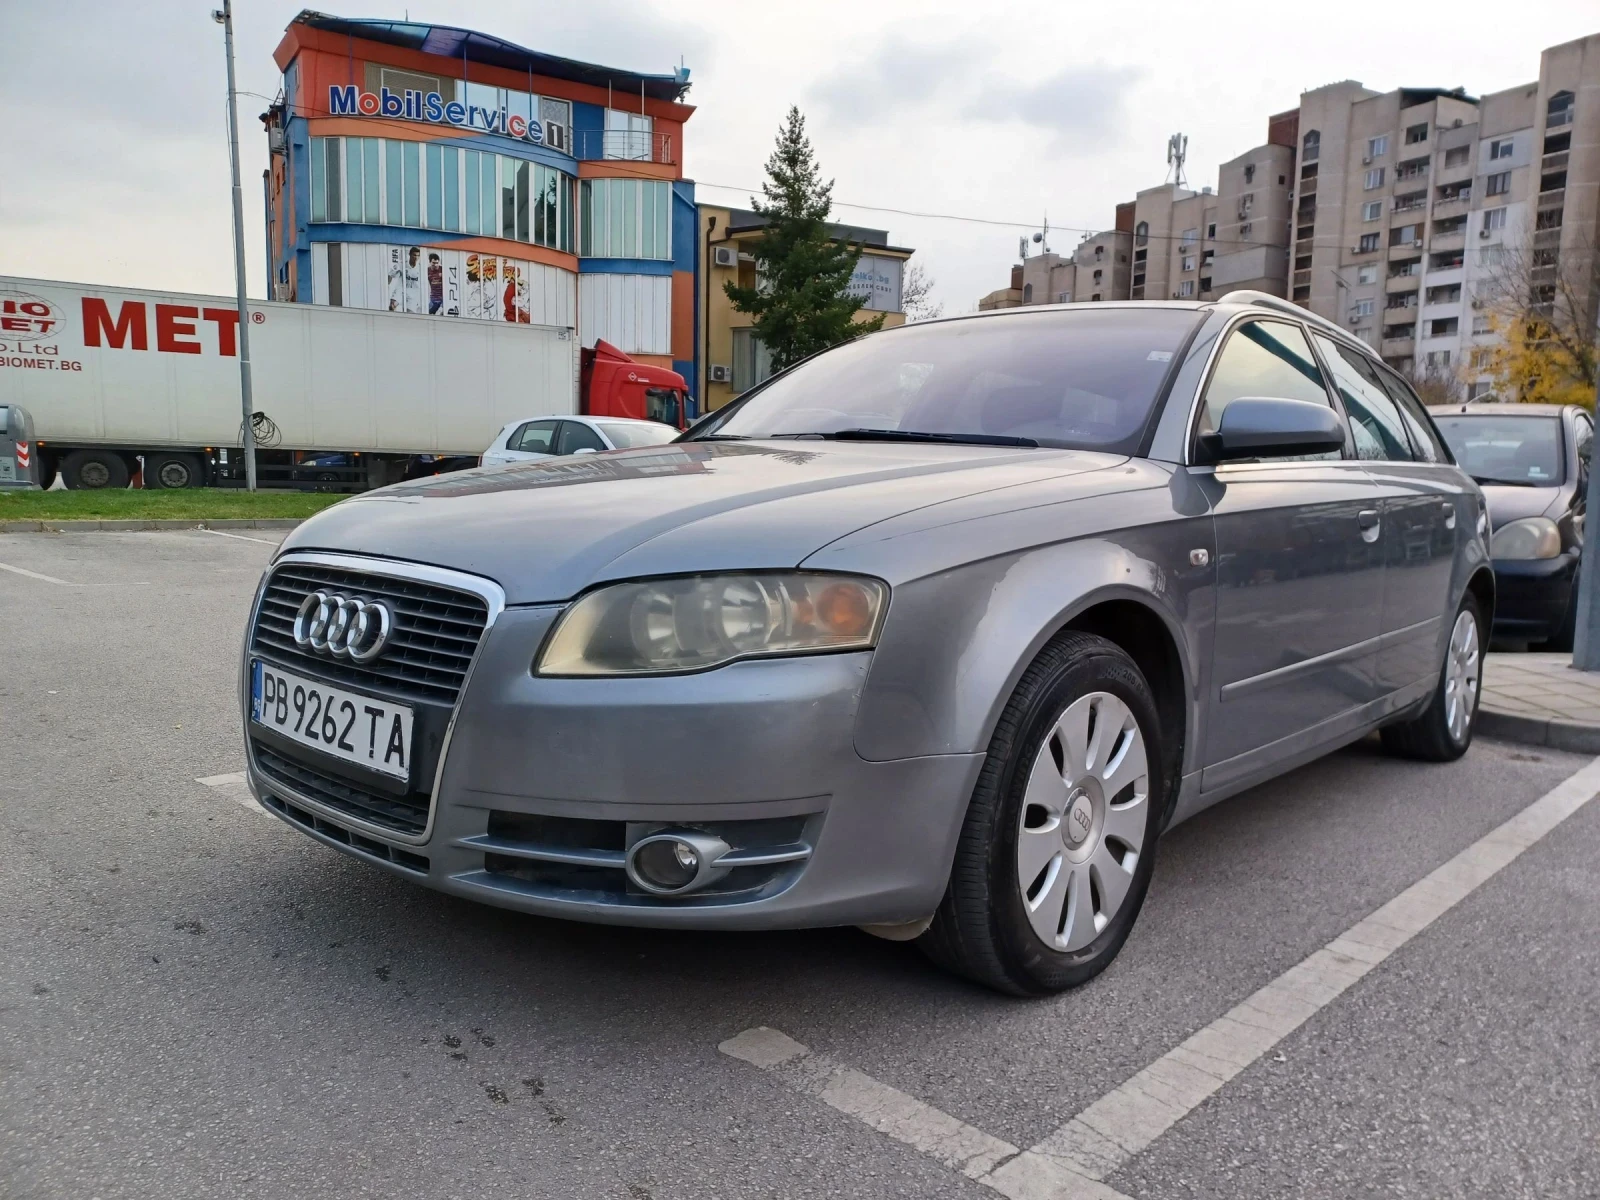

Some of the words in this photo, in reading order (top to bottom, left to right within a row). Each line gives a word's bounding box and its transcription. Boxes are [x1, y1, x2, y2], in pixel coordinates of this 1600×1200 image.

[391, 248, 399, 263] FIFA
[449, 266, 458, 301] PS4
[81, 296, 249, 357] MET
